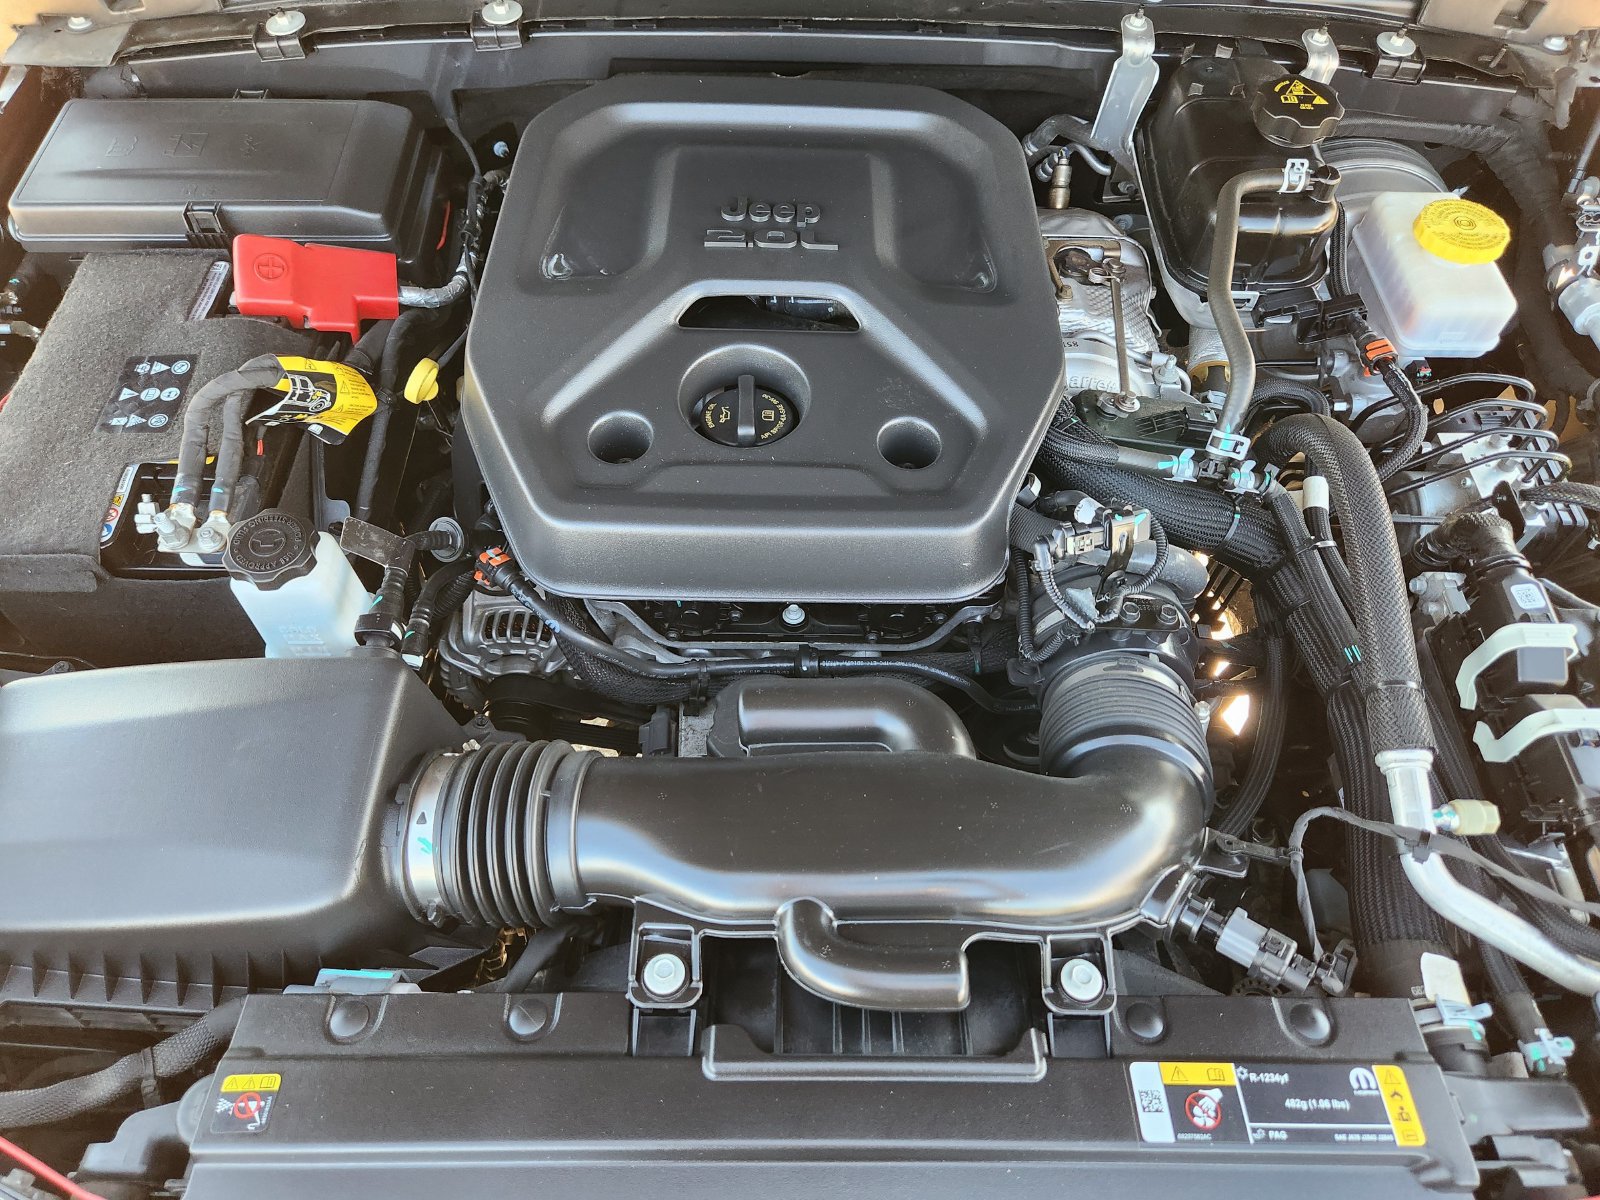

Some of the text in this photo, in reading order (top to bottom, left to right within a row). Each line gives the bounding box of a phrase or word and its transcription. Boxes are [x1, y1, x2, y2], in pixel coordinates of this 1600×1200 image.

[720, 196, 821, 228] Jeep
[703, 228, 839, 251] 2.0L
[704, 402, 718, 429] ENGINE OIL
[760, 431, 773, 440] API
[233, 516, 302, 545] POWER STEERING FLUID
[235, 554, 278, 571] APPROVED
[1249, 1072, 1290, 1086] R-1234yf
[1331, 1098, 1350, 1112] lbs)
[1268, 1130, 1288, 1141] PAG
